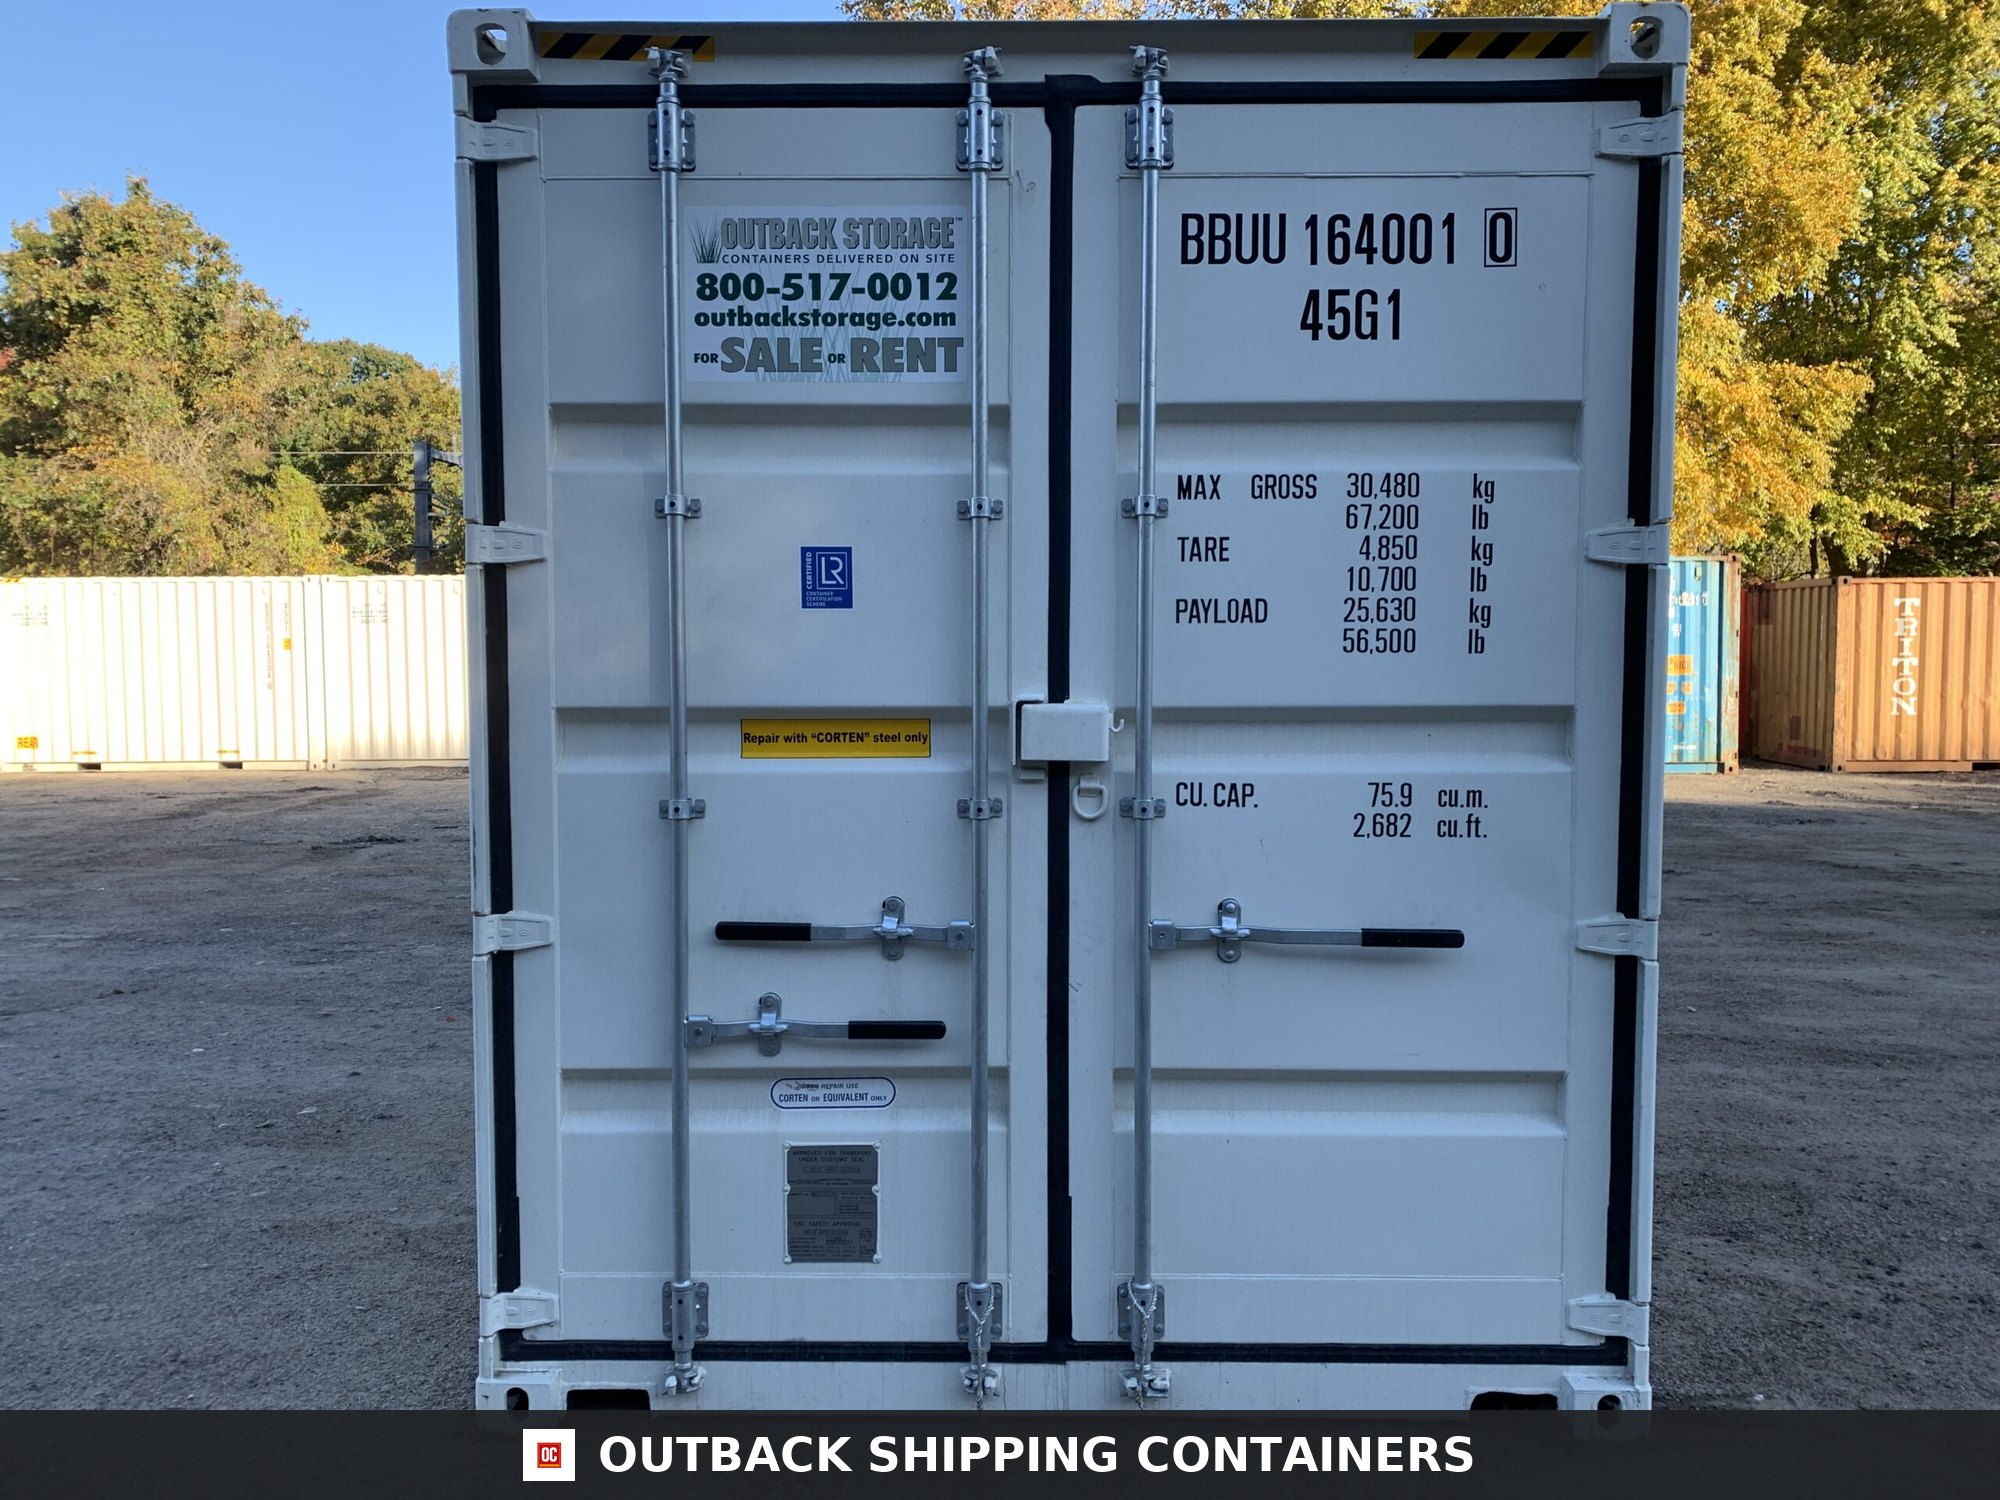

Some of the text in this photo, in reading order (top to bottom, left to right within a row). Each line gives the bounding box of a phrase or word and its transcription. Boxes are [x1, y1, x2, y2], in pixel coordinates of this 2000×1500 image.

[721, 217, 838, 250] OUTBACK
[1180, 212, 1287, 265] BBUU
[1304, 212, 1456, 266] 164001
[722, 253, 955, 264] CONTAINERS DELIVERED ON SITE
[696, 272, 958, 301] 800-517-0012
[694, 305, 956, 331] outbackstorage.com
[1300, 288, 1401, 341] 45G1
[694, 337, 964, 373] FOR SALE OR RENT
[1177, 472, 1496, 504] MAX GROSS 30,480 kg
[1345, 503, 1489, 531] 67,200 lb
[1177, 535, 1494, 566] TARE 4,850 kg
[821, 556, 845, 585] LR
[1346, 566, 1487, 593] 10,700 lb
[1175, 596, 1492, 629] PAYLOAD 25,630 kg
[1342, 627, 1485, 655] 56,500 lb
[1891, 597, 1920, 716] TRITON
[743, 732, 780, 746] Repair
[783, 732, 808, 743] with
[873, 732, 901, 743] steel
[904, 732, 928, 745] only
[1367, 782, 1413, 808] 75.9
[1437, 788, 1489, 808] cu.m.
[1353, 813, 1488, 839] 2,682 cu.ft.
[779, 1093, 808, 1103] CORTEN
[823, 1092, 869, 1102] EQUIVALENT
